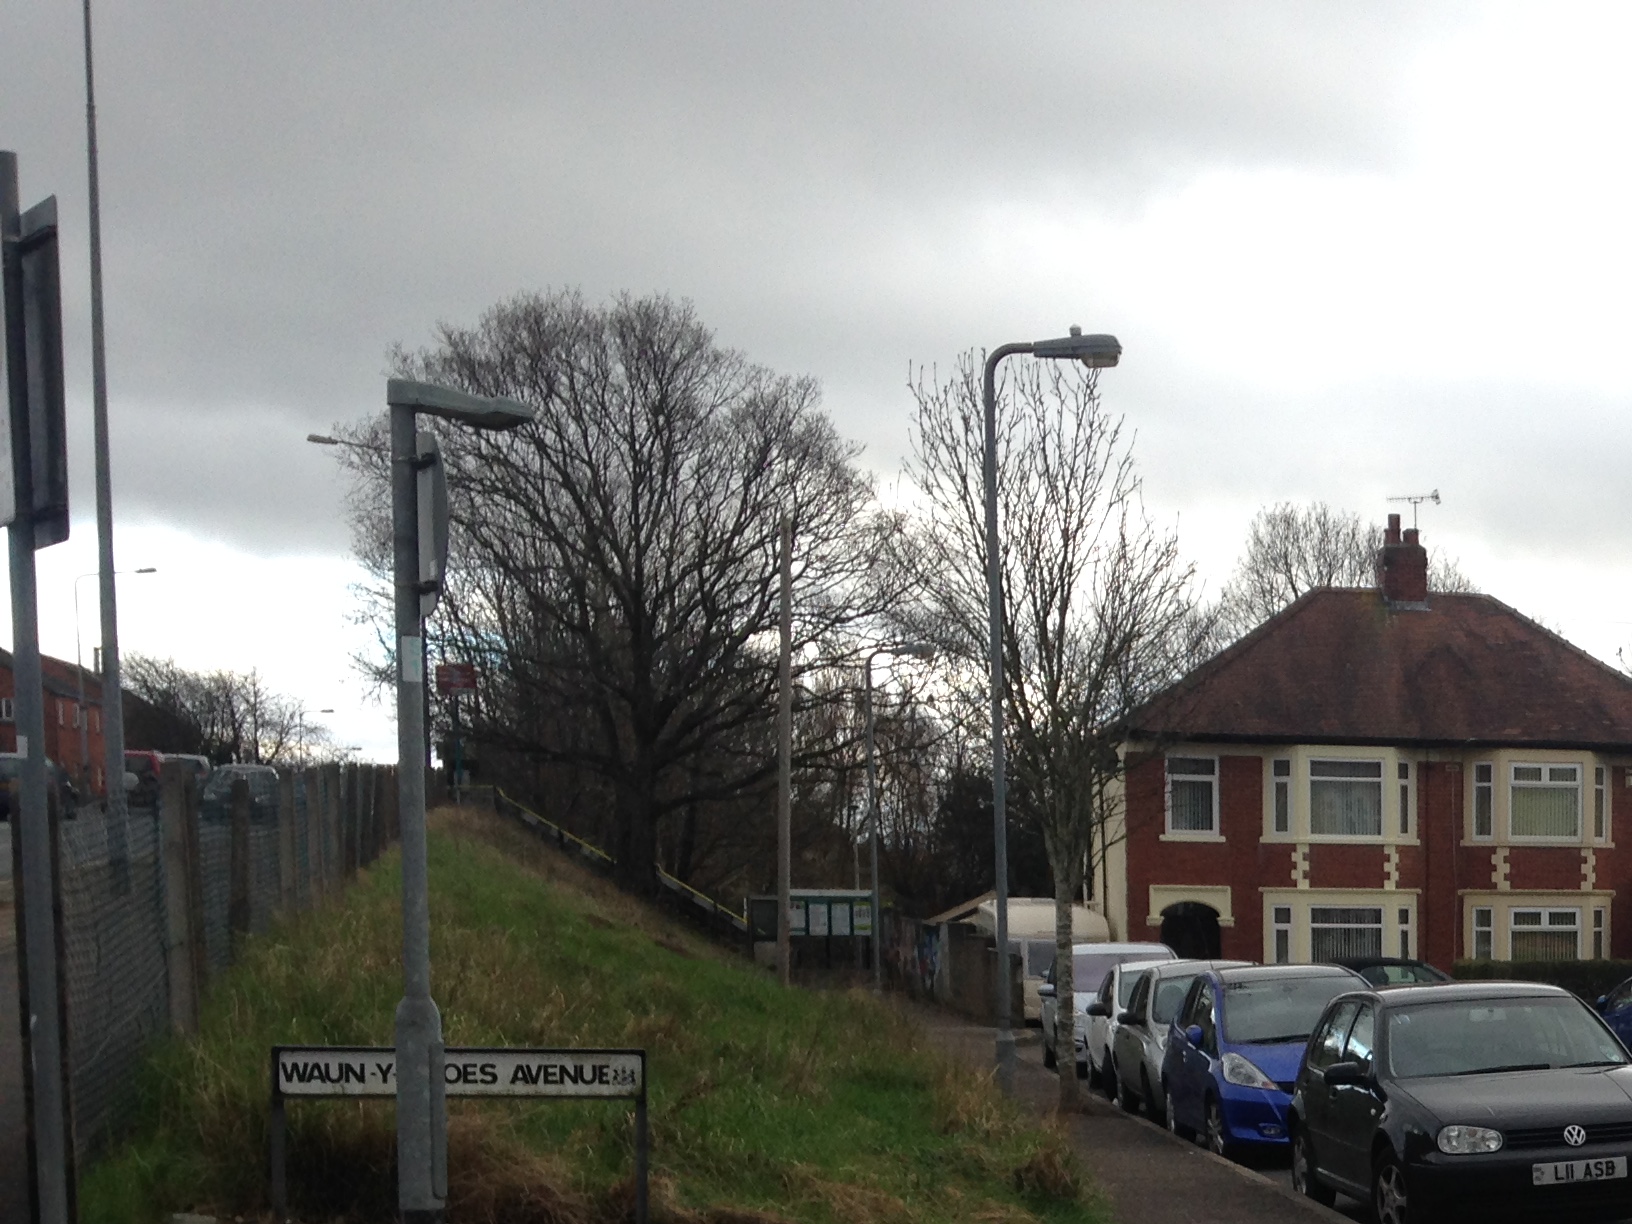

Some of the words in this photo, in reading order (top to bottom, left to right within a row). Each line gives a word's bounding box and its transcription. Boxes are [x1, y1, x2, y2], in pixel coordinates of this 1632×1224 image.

[281, 1062, 498, 1085] WAUN-Y-OES
[510, 1063, 611, 1086] AVENUE
[1583, 1160, 1616, 1178] ASB
